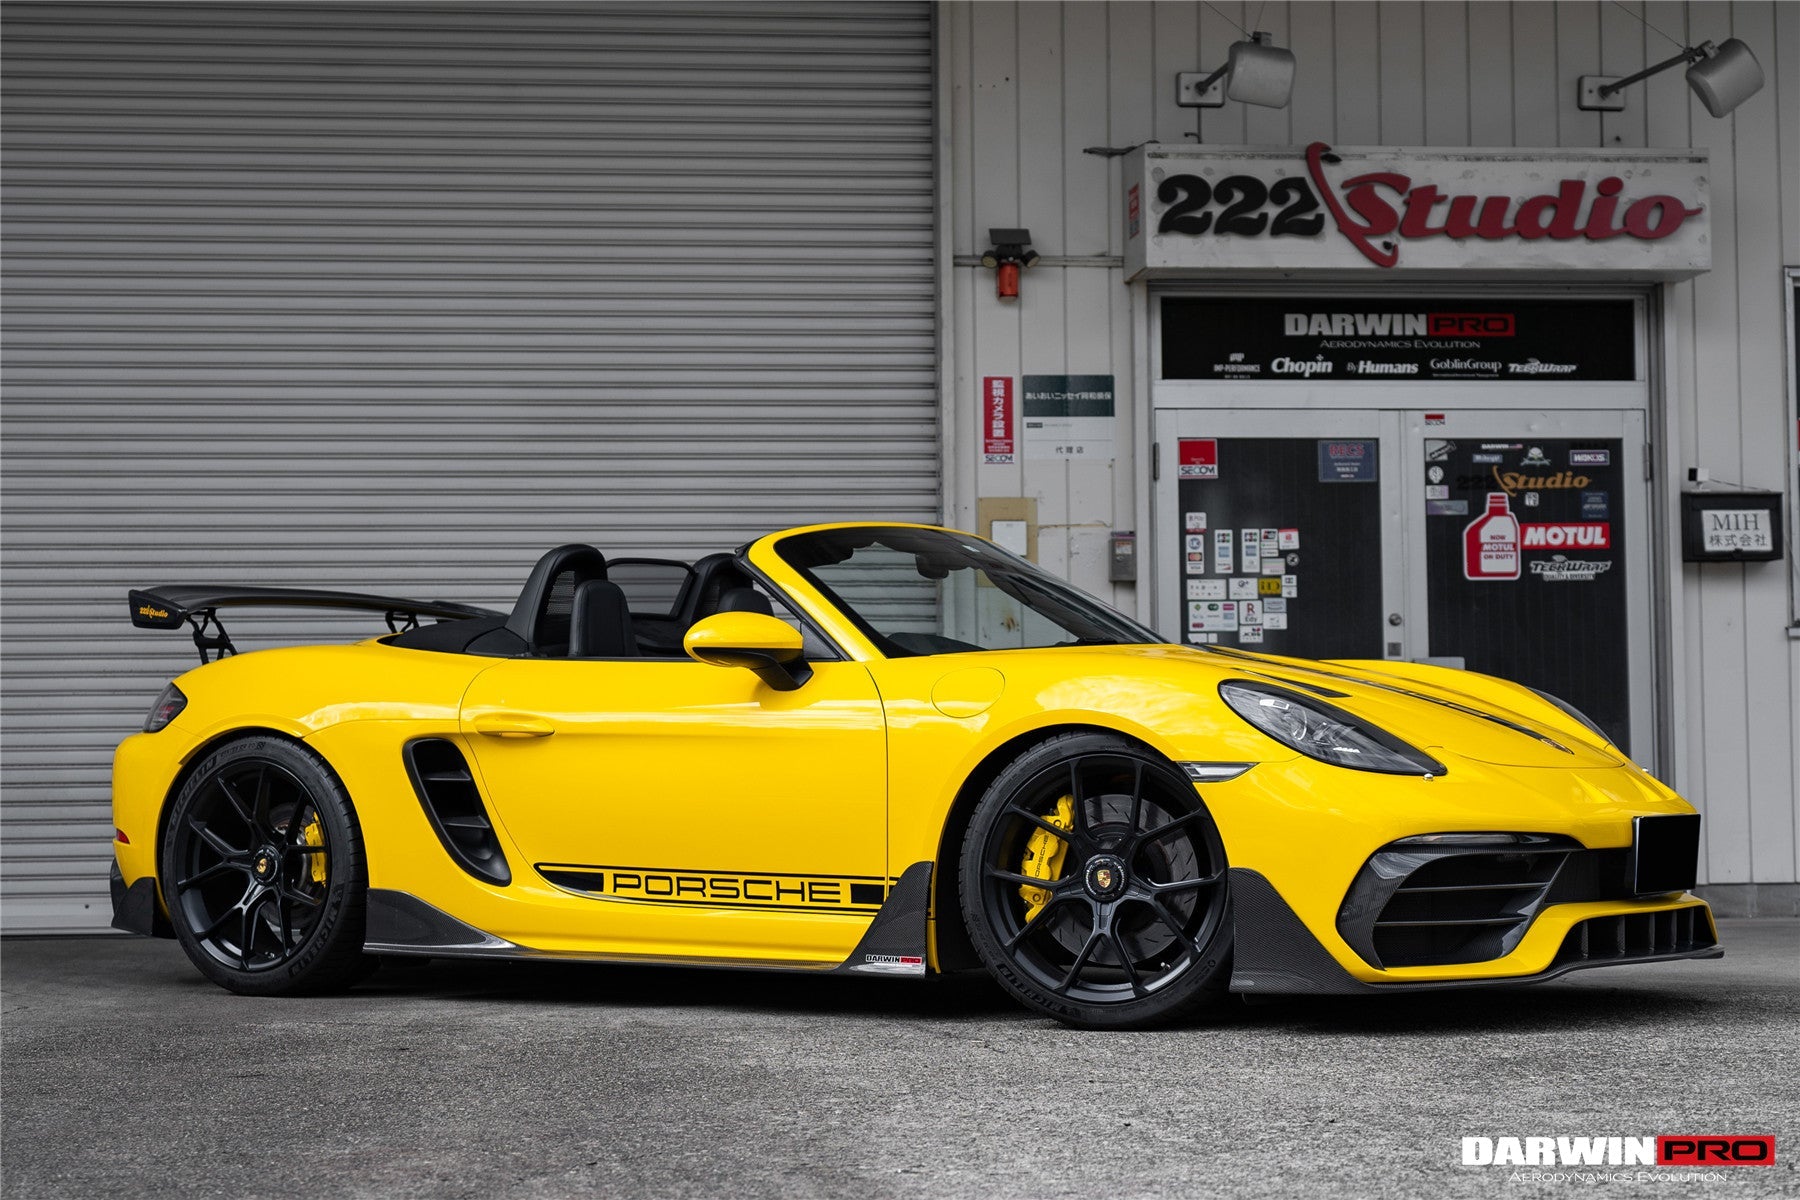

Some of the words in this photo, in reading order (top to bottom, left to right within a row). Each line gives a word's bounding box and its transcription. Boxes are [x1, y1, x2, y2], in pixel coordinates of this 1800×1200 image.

[1158, 173, 1324, 236] 222
[1325, 160, 1702, 250] Studio
[1285, 313, 1427, 336] DARWIN
[1433, 316, 1509, 333] PRO
[1271, 354, 1333, 377] Chopin
[1358, 360, 1419, 374] Humans
[1430, 357, 1502, 373] GoblinGroup
[985, 454, 1013, 463] SECOM
[1180, 465, 1215, 475] SECOM
[1498, 468, 1592, 492] Studio
[1712, 513, 1760, 531] MIH
[1524, 526, 1606, 546] MOTUL
[1709, 534, 1768, 547] 株式会社
[1482, 543, 1514, 551] MOTUL
[1034, 834, 1049, 878] ORSCHE
[613, 872, 841, 903] PORSCHE
[866, 954, 900, 963] DARWIN
